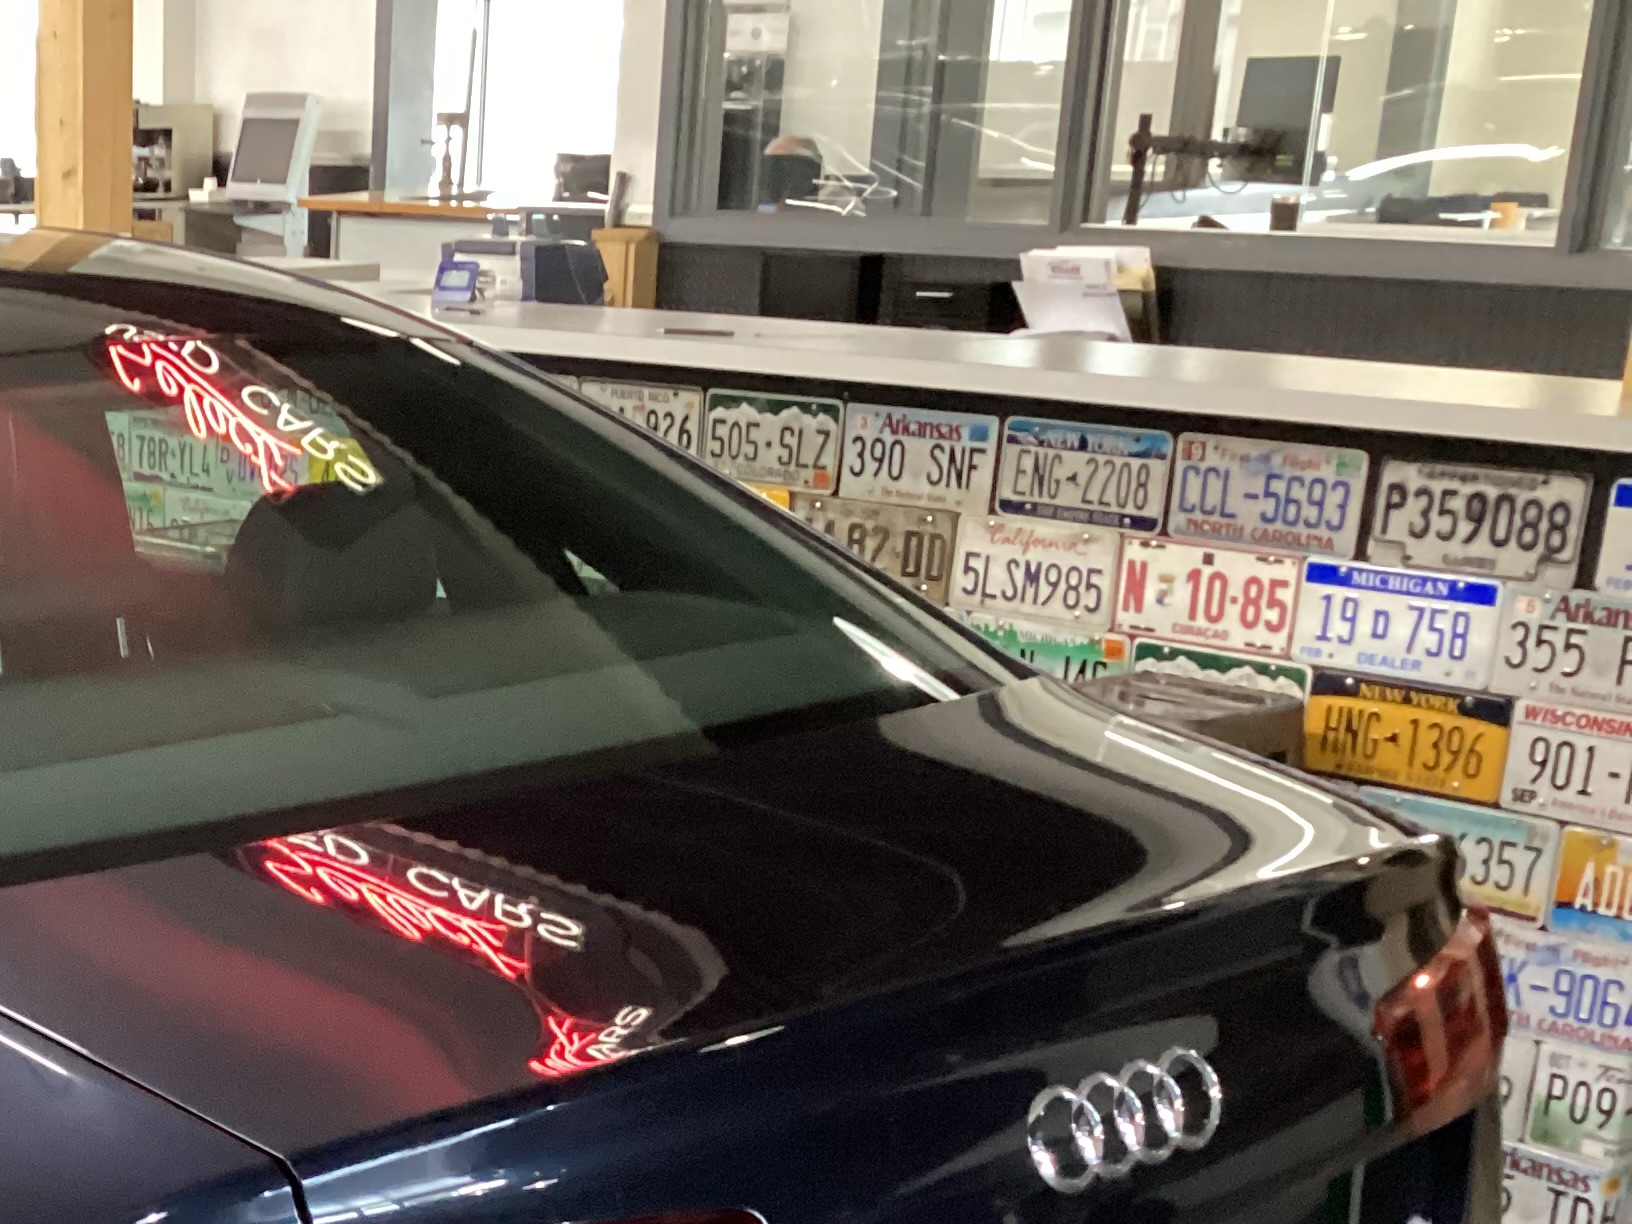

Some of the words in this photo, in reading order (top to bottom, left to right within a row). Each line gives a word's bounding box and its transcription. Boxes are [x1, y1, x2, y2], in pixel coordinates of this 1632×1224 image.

[879, 412, 962, 442] Arkansas
[849, 435, 906, 481] 390
[925, 442, 987, 490] SNF
[1178, 464, 1351, 532] CCL-5693
[1380, 481, 1571, 554] P359088
[989, 521, 1092, 555] California
[1186, 517, 1244, 539] NORTH
[1250, 527, 1334, 552] CAROLINA
[962, 552, 1103, 612] 5LSM985
[1122, 559, 1148, 614] N
[1351, 570, 1449, 596] MICHIGAN
[1315, 593, 1359, 645] 19
[1371, 609, 1390, 640] D
[1405, 603, 1471, 661] 758
[1504, 621, 1588, 677] 355
[1357, 651, 1423, 672] DEALER
